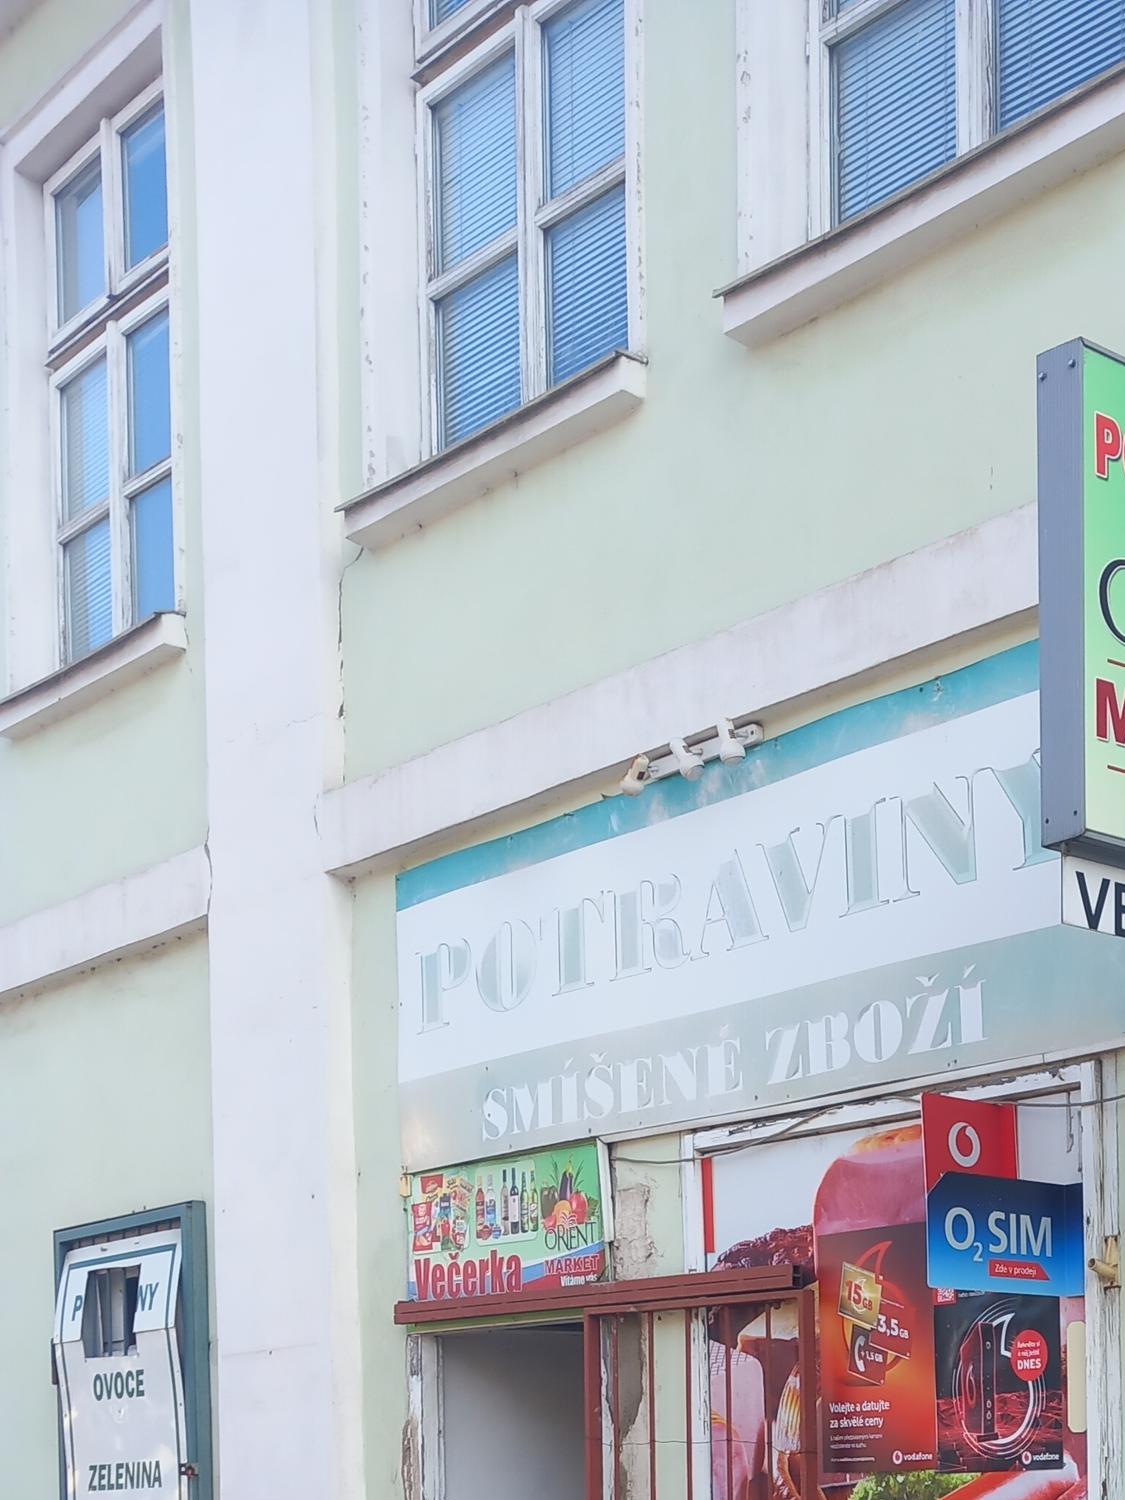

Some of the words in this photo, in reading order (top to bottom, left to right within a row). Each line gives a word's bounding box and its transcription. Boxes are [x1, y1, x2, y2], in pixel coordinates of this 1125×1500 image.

[414, 748, 1060, 1035] POTRAVINY
[482, 1024, 744, 1142] SMÍŠENÉ
[764, 963, 989, 1080] ZBOŽÍ
[545, 1222, 597, 1251] ORIENT
[988, 1210, 1052, 1258] SIM
[414, 1249, 523, 1301] Večerka
[544, 1253, 600, 1275] MARKET
[995, 1264, 1007, 1273] Zde
[1014, 1265, 1037, 1278] prodeji
[846, 1280, 863, 1306] 15
[1017, 1358, 1041, 1370] DNES
[93, 1369, 145, 1401] OVOCE
[829, 1402, 855, 1415] Volejte
[862, 1400, 890, 1412] datujte
[829, 1420, 839, 1428] za
[840, 1415, 864, 1428] skvělé
[864, 1417, 883, 1428] ceny
[904, 1452, 933, 1461] vodafone
[1033, 1452, 1059, 1461] vodafone
[88, 1460, 162, 1491] ZELENINA
